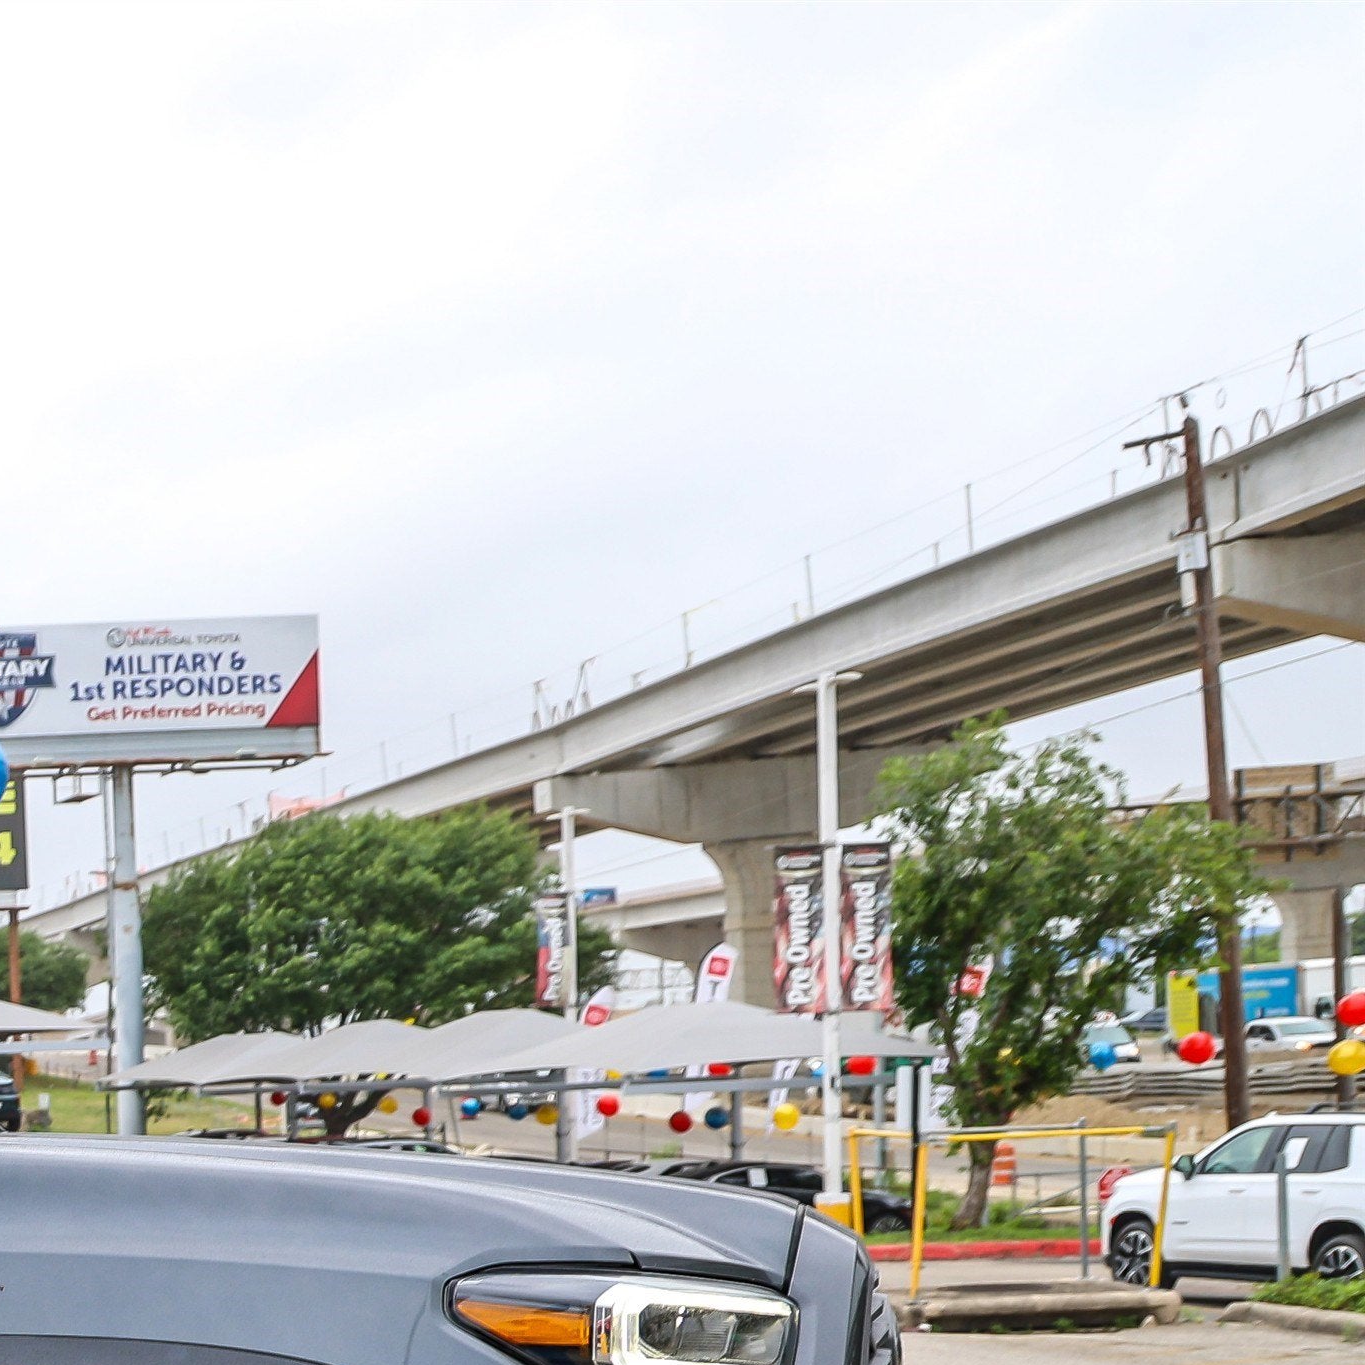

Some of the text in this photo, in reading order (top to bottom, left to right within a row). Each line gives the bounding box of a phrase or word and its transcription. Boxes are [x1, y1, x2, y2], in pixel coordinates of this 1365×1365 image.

[105, 651, 246, 676] MILITARY &
[70, 674, 282, 702] 1st RESPONDERS
[86, 701, 267, 722] Get Preferred Pricing
[784, 883, 811, 963] Owned
[850, 880, 876, 960] Owned
[785, 966, 813, 1006] Pre
[851, 964, 879, 1003] Pre
